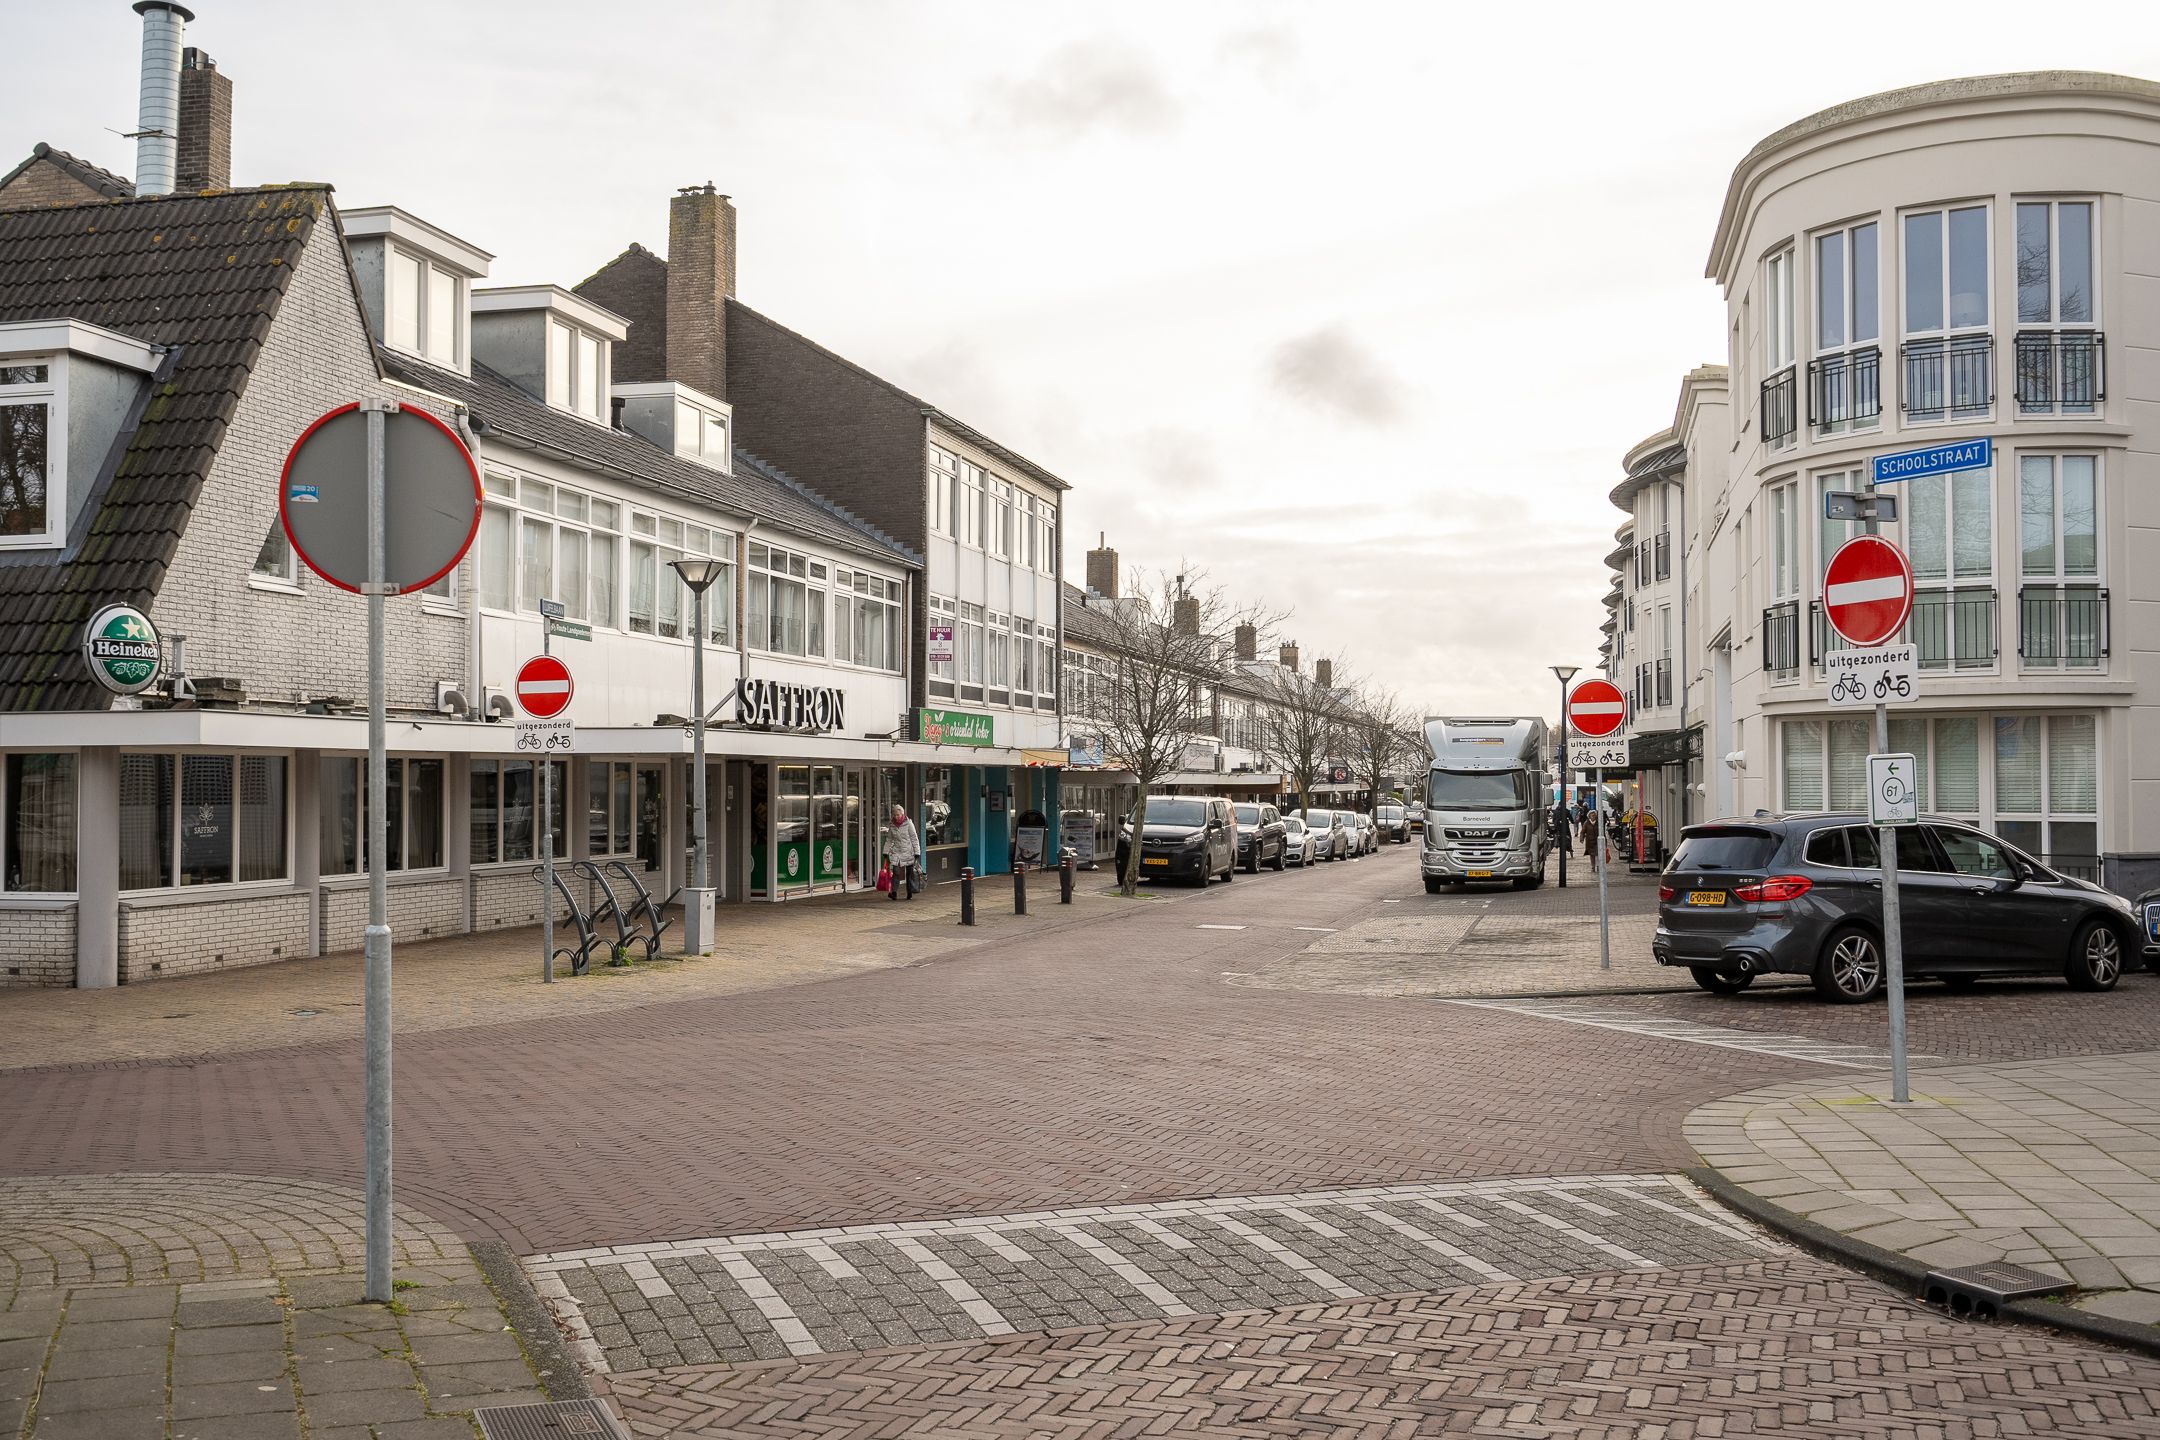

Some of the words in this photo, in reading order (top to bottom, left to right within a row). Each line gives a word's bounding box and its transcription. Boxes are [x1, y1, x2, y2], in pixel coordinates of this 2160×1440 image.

[1881, 446, 1980, 475] SCHOOLSTRAAT
[96, 641, 158, 659] Heineken
[1829, 650, 1910, 669] uitgezonderd
[738, 678, 847, 737] SAFFRON
[517, 721, 571, 731] uitgezonderd
[1570, 740, 1625, 749] uitgezonderd
[1886, 785, 1898, 797] 61
[194, 825, 219, 834] SAFFRON
[1690, 892, 1724, 903] G-098-HD
